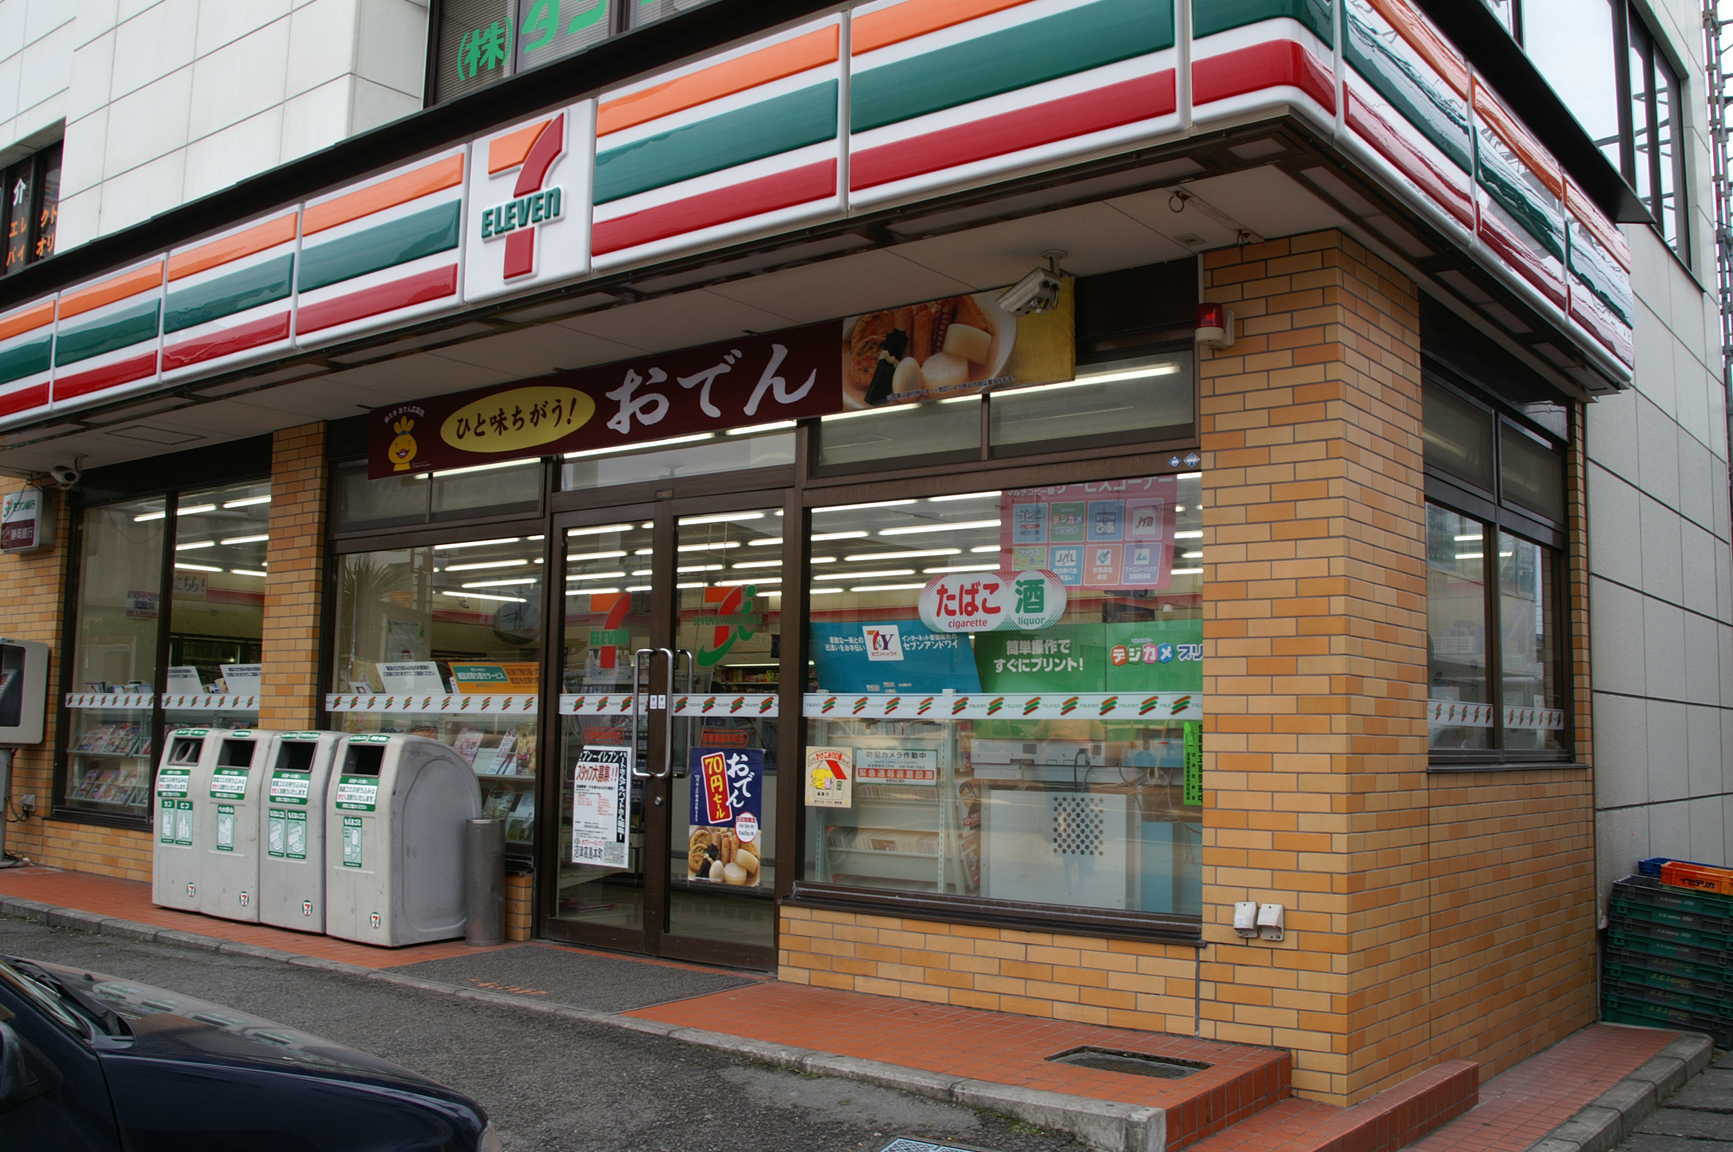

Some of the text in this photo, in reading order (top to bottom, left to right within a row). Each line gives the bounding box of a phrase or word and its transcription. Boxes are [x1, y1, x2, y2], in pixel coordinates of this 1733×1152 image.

[487, 112, 564, 280] 7
[606, 343, 818, 436] おでん
[455, 397, 577, 440] ひと味ちがう!
[936, 582, 1001, 617] たばこ
[1014, 579, 1045, 615] 酒
[947, 619, 988, 628] cigarette
[1018, 615, 1046, 627] liquor
[994, 658, 1084, 673] すぐにプリント!
[1006, 640, 1072, 656] 簡単操作で
[704, 757, 725, 819] 70円セール
[726, 753, 755, 808] おでん
